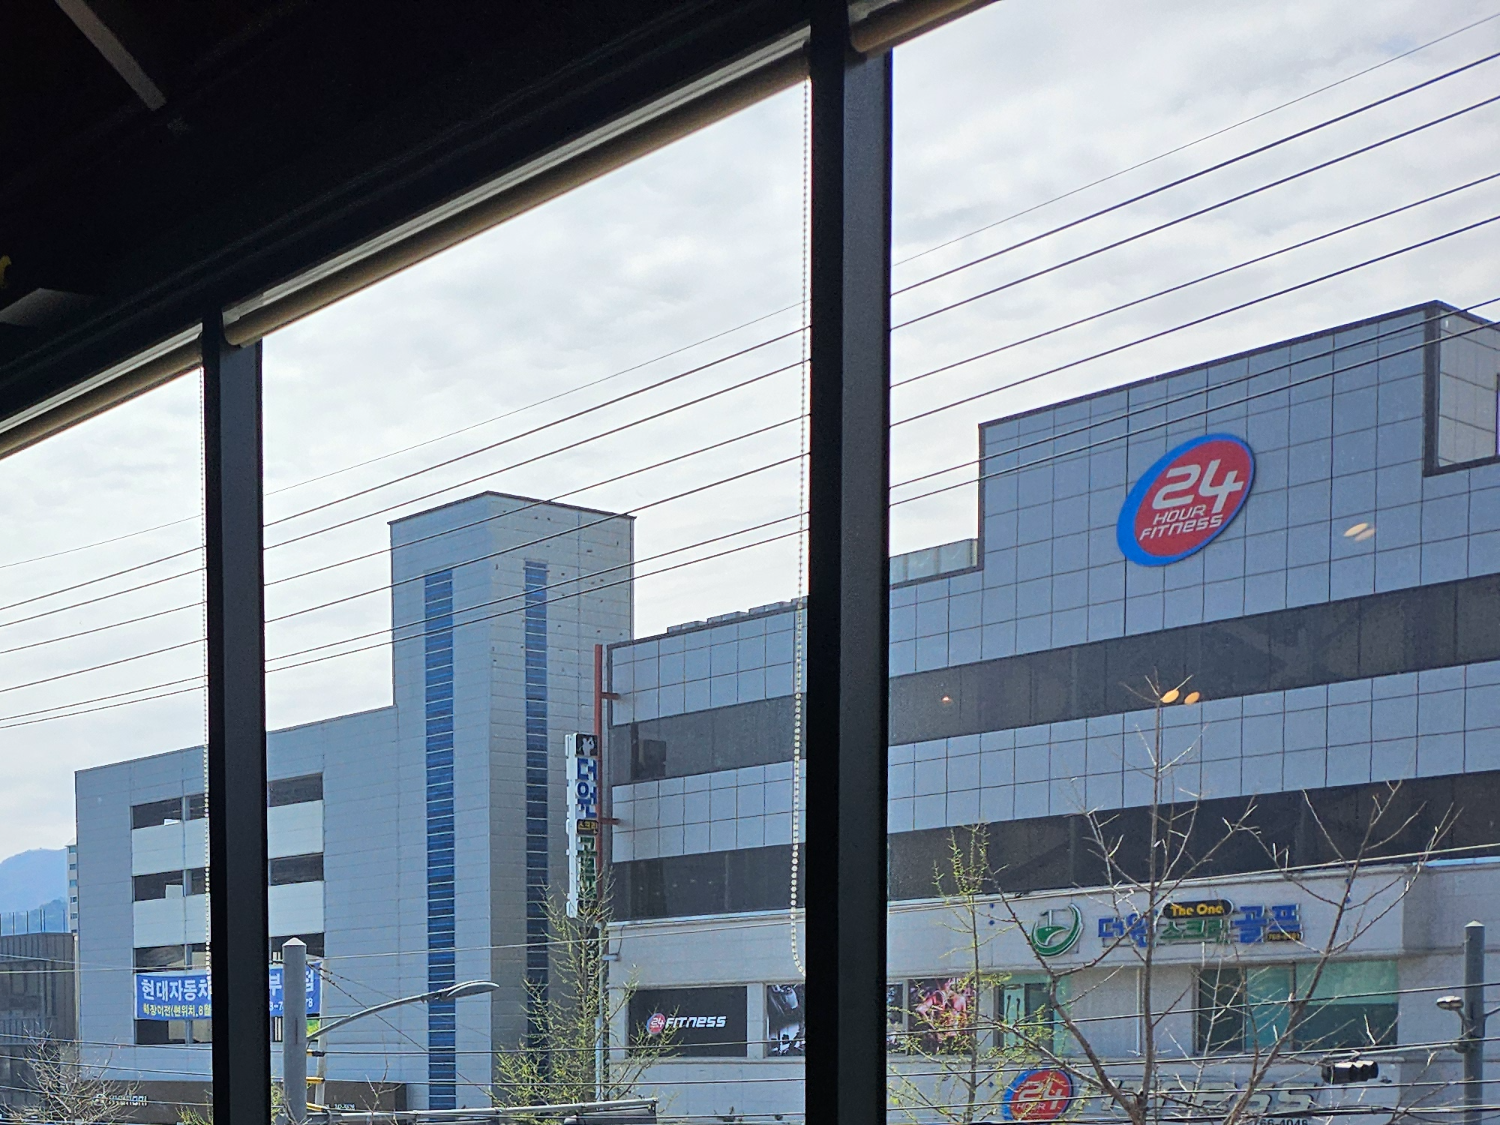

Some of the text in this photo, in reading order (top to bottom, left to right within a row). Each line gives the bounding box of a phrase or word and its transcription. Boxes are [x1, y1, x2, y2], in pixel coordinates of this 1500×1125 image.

[1152, 458, 1244, 514] 24
[1153, 504, 1206, 525] HOUR
[1139, 514, 1224, 541] FITNESS
[1170, 902, 1224, 917] The One
[1159, 920, 1232, 945] 스크린
[1235, 904, 1303, 944] 골프
[141, 978, 211, 1002] 현대자동차
[650, 1015, 727, 1030] 24 FITNESS
[1018, 1080, 1067, 1110] 24
